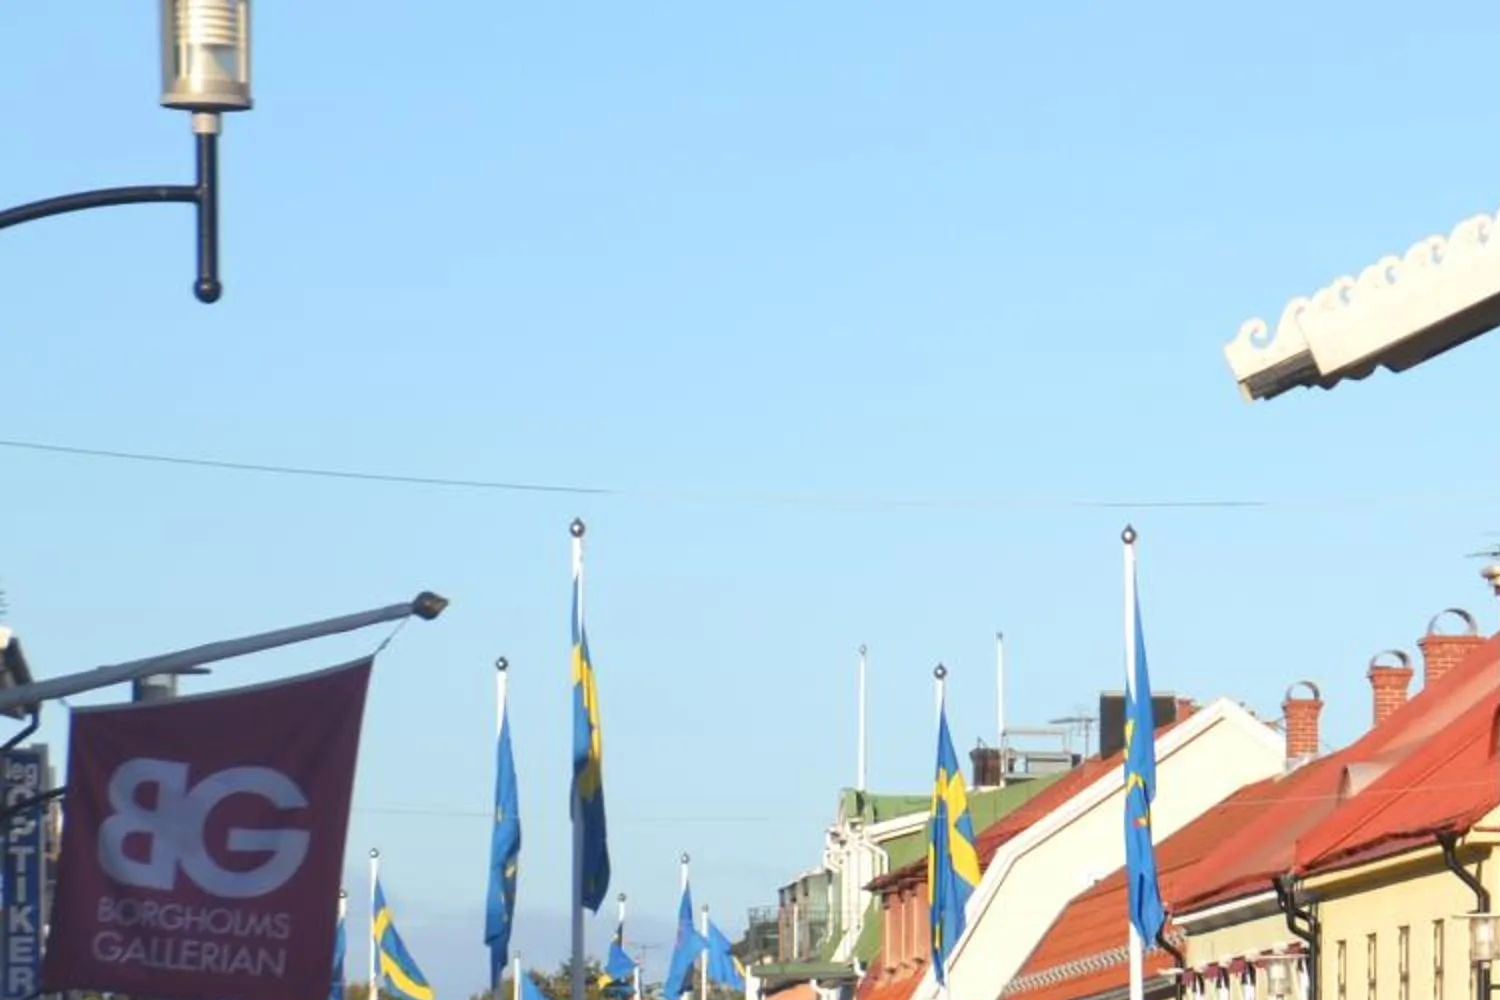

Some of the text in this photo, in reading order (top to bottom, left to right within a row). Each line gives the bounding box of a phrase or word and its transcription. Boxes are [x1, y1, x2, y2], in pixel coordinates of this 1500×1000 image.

[8, 786, 37, 994] OPTIKER
[96, 898, 291, 940] BORGHOLMS
[92, 931, 287, 977] GALLERIAN
